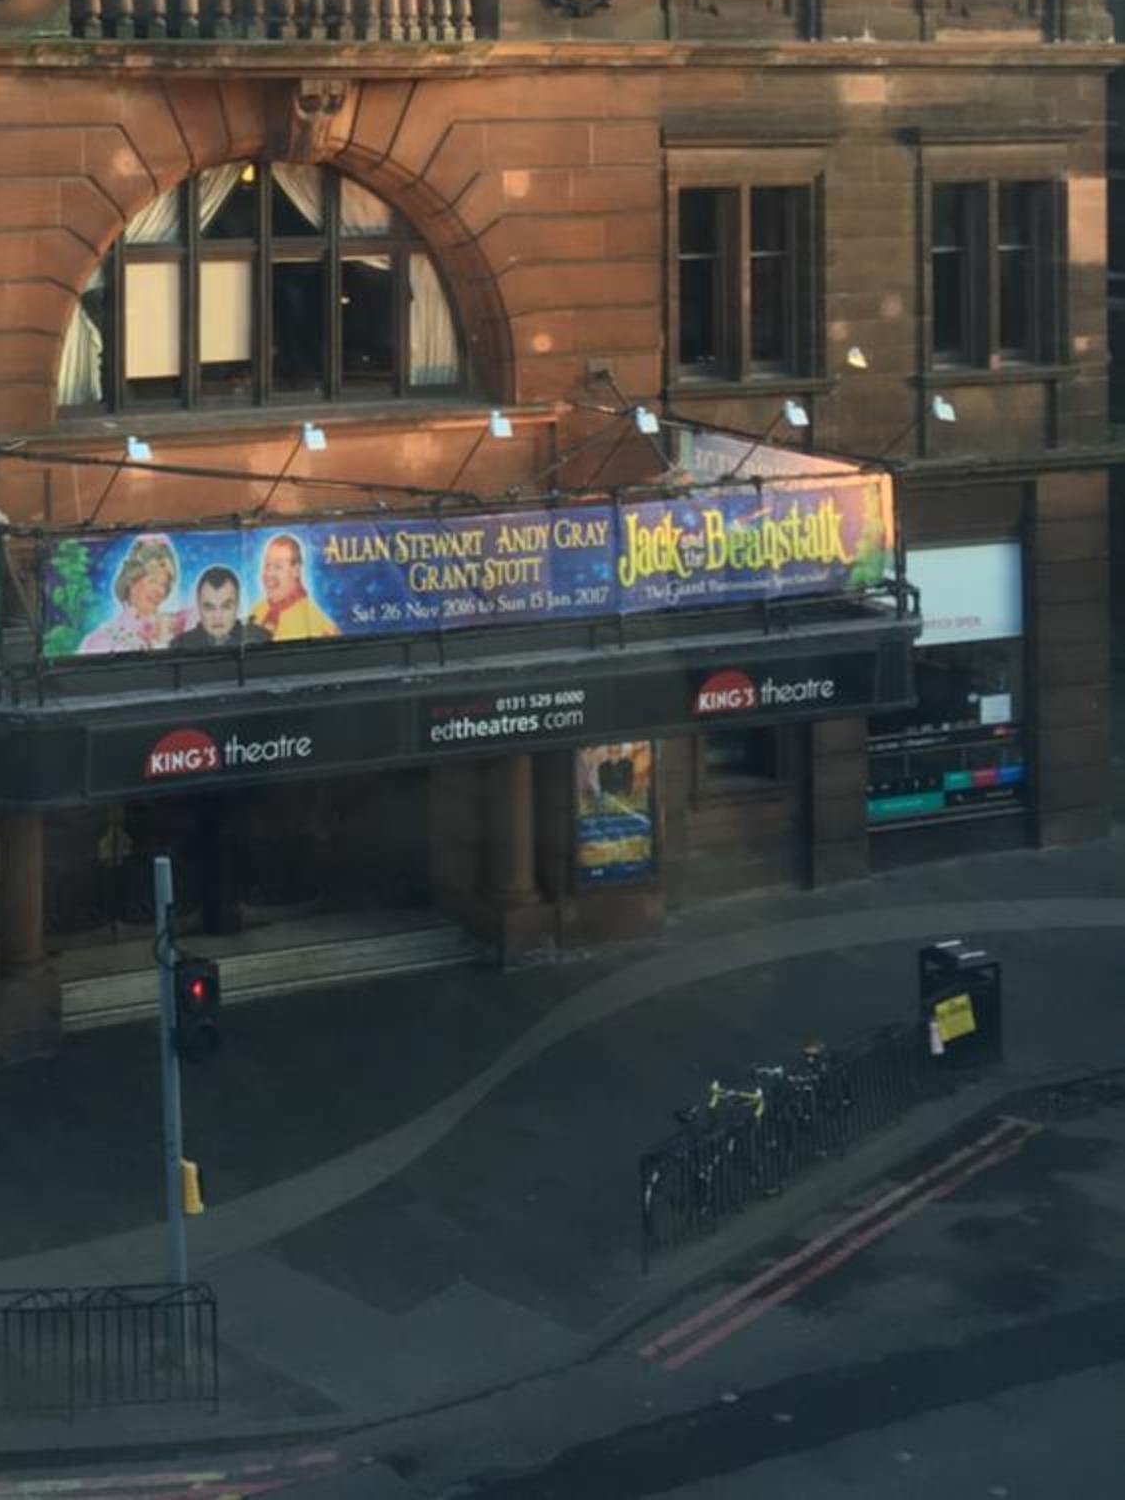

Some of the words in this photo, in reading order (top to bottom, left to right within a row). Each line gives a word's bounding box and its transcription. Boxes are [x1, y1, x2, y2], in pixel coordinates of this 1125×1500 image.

[323, 534, 390, 564] ALLAN
[394, 530, 484, 563] STEWART
[495, 523, 550, 554] ANDY
[554, 519, 609, 548] GRAY
[618, 510, 693, 588] Jack
[683, 550, 706, 568] the
[701, 497, 854, 572] Beanstalk
[409, 562, 480, 592] GRANT
[481, 557, 542, 590] STOTT
[351, 604, 375, 623] Sat
[380, 602, 402, 620] 26
[405, 601, 437, 619] Nov
[441, 598, 475, 618] 2016
[497, 594, 525, 612] Sun
[545, 590, 572, 610] Jan
[576, 586, 609, 605] 2017
[698, 687, 756, 711] KING'S
[761, 677, 836, 705] theatre
[150, 745, 218, 774] KING'S
[224, 734, 312, 765] theatre
